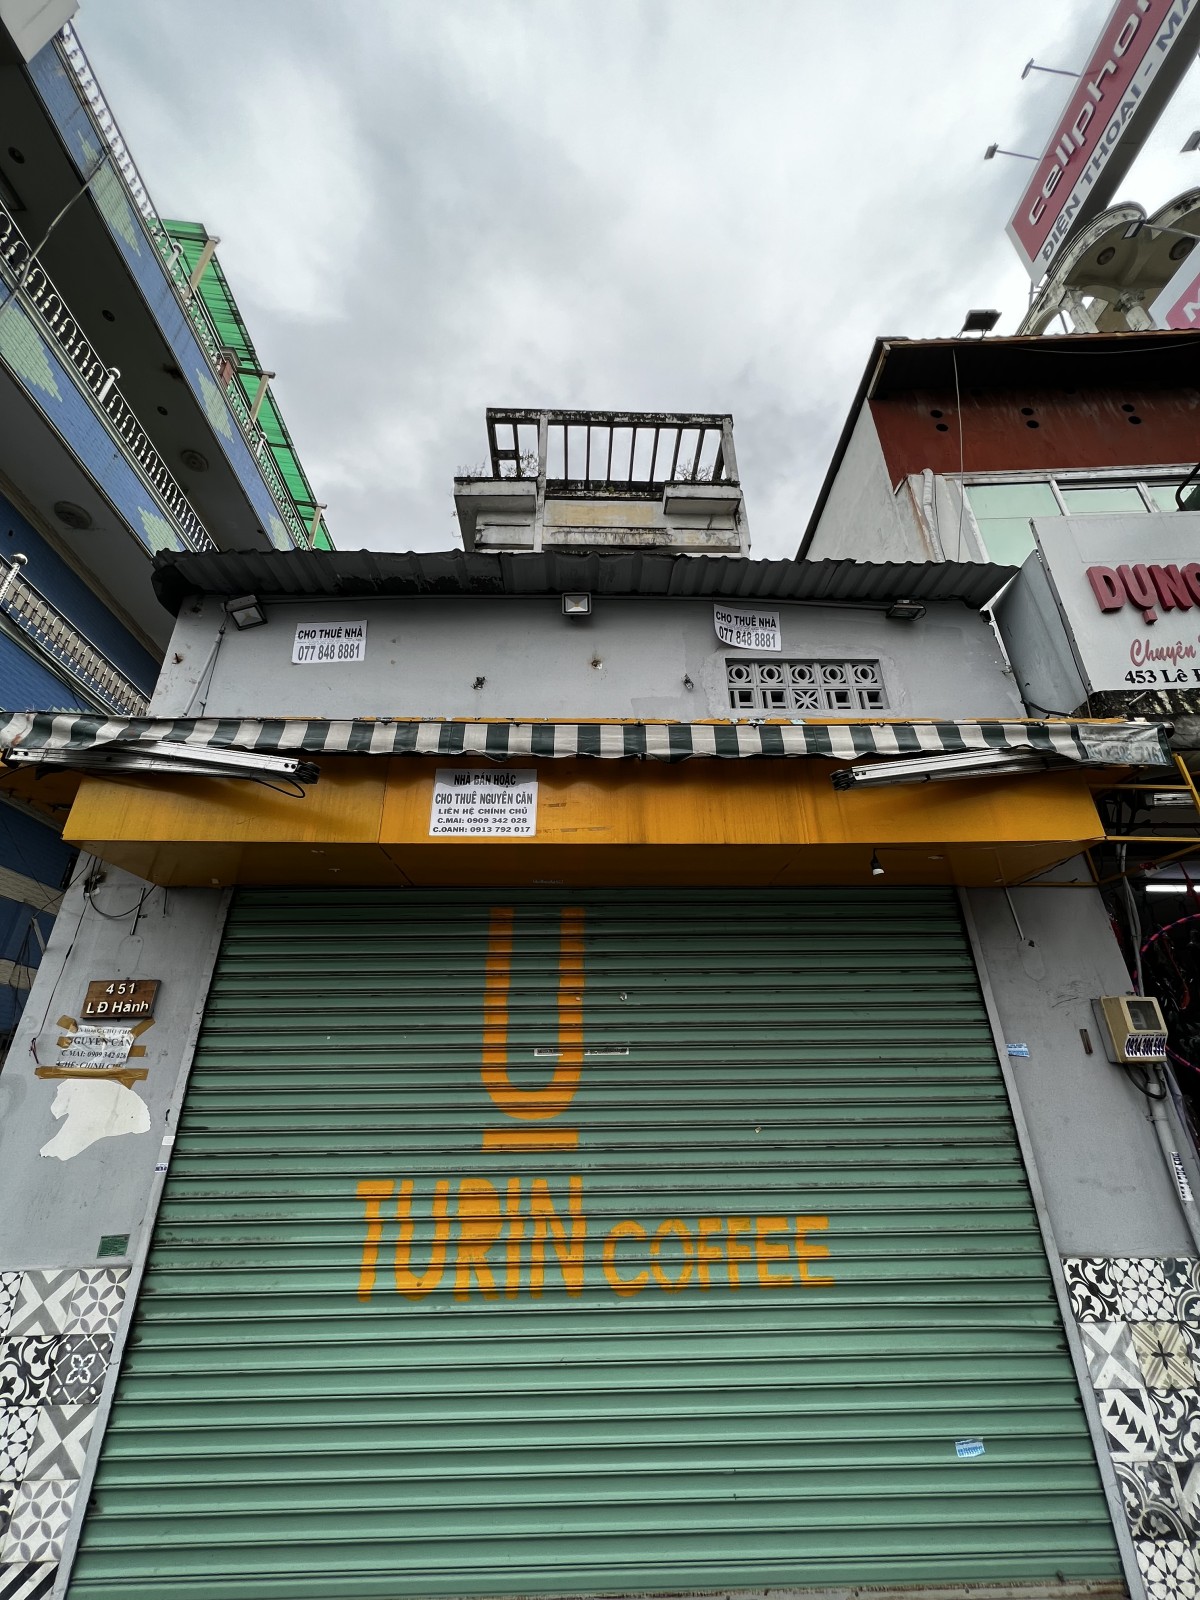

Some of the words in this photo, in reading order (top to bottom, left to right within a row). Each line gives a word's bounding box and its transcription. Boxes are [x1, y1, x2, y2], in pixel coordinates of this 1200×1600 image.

[1041, 193, 1081, 262] ĐIỆN
[1081, 84, 1142, 186] THOẠI
[716, 611, 732, 623] CHO
[734, 615, 756, 626] THUÊ
[759, 616, 776, 628] NHÀ
[298, 630, 317, 639] CHO
[719, 626, 733, 642] 077
[736, 631, 751, 646] 848
[755, 633, 776, 647] 8881
[298, 646, 316, 661] 077
[318, 645, 335, 660] 848
[338, 643, 360, 659] 8881
[1130, 639, 1196, 667] Chuyên
[1125, 670, 1157, 684] 453
[1160, 669, 1188, 682] Lê
[454, 772, 471, 785] NHÀ
[473, 772, 491, 785] BÁN
[493, 773, 516, 788] HOẶC
[435, 793, 452, 804] CHO
[455, 791, 476, 804] THUÊ
[480, 791, 513, 804] NGUYÊN
[516, 792, 532, 804] CĂN
[106, 983, 135, 994] 451
[356, 1175, 587, 1302] TURIN
[603, 1215, 835, 1298] COFFEE
